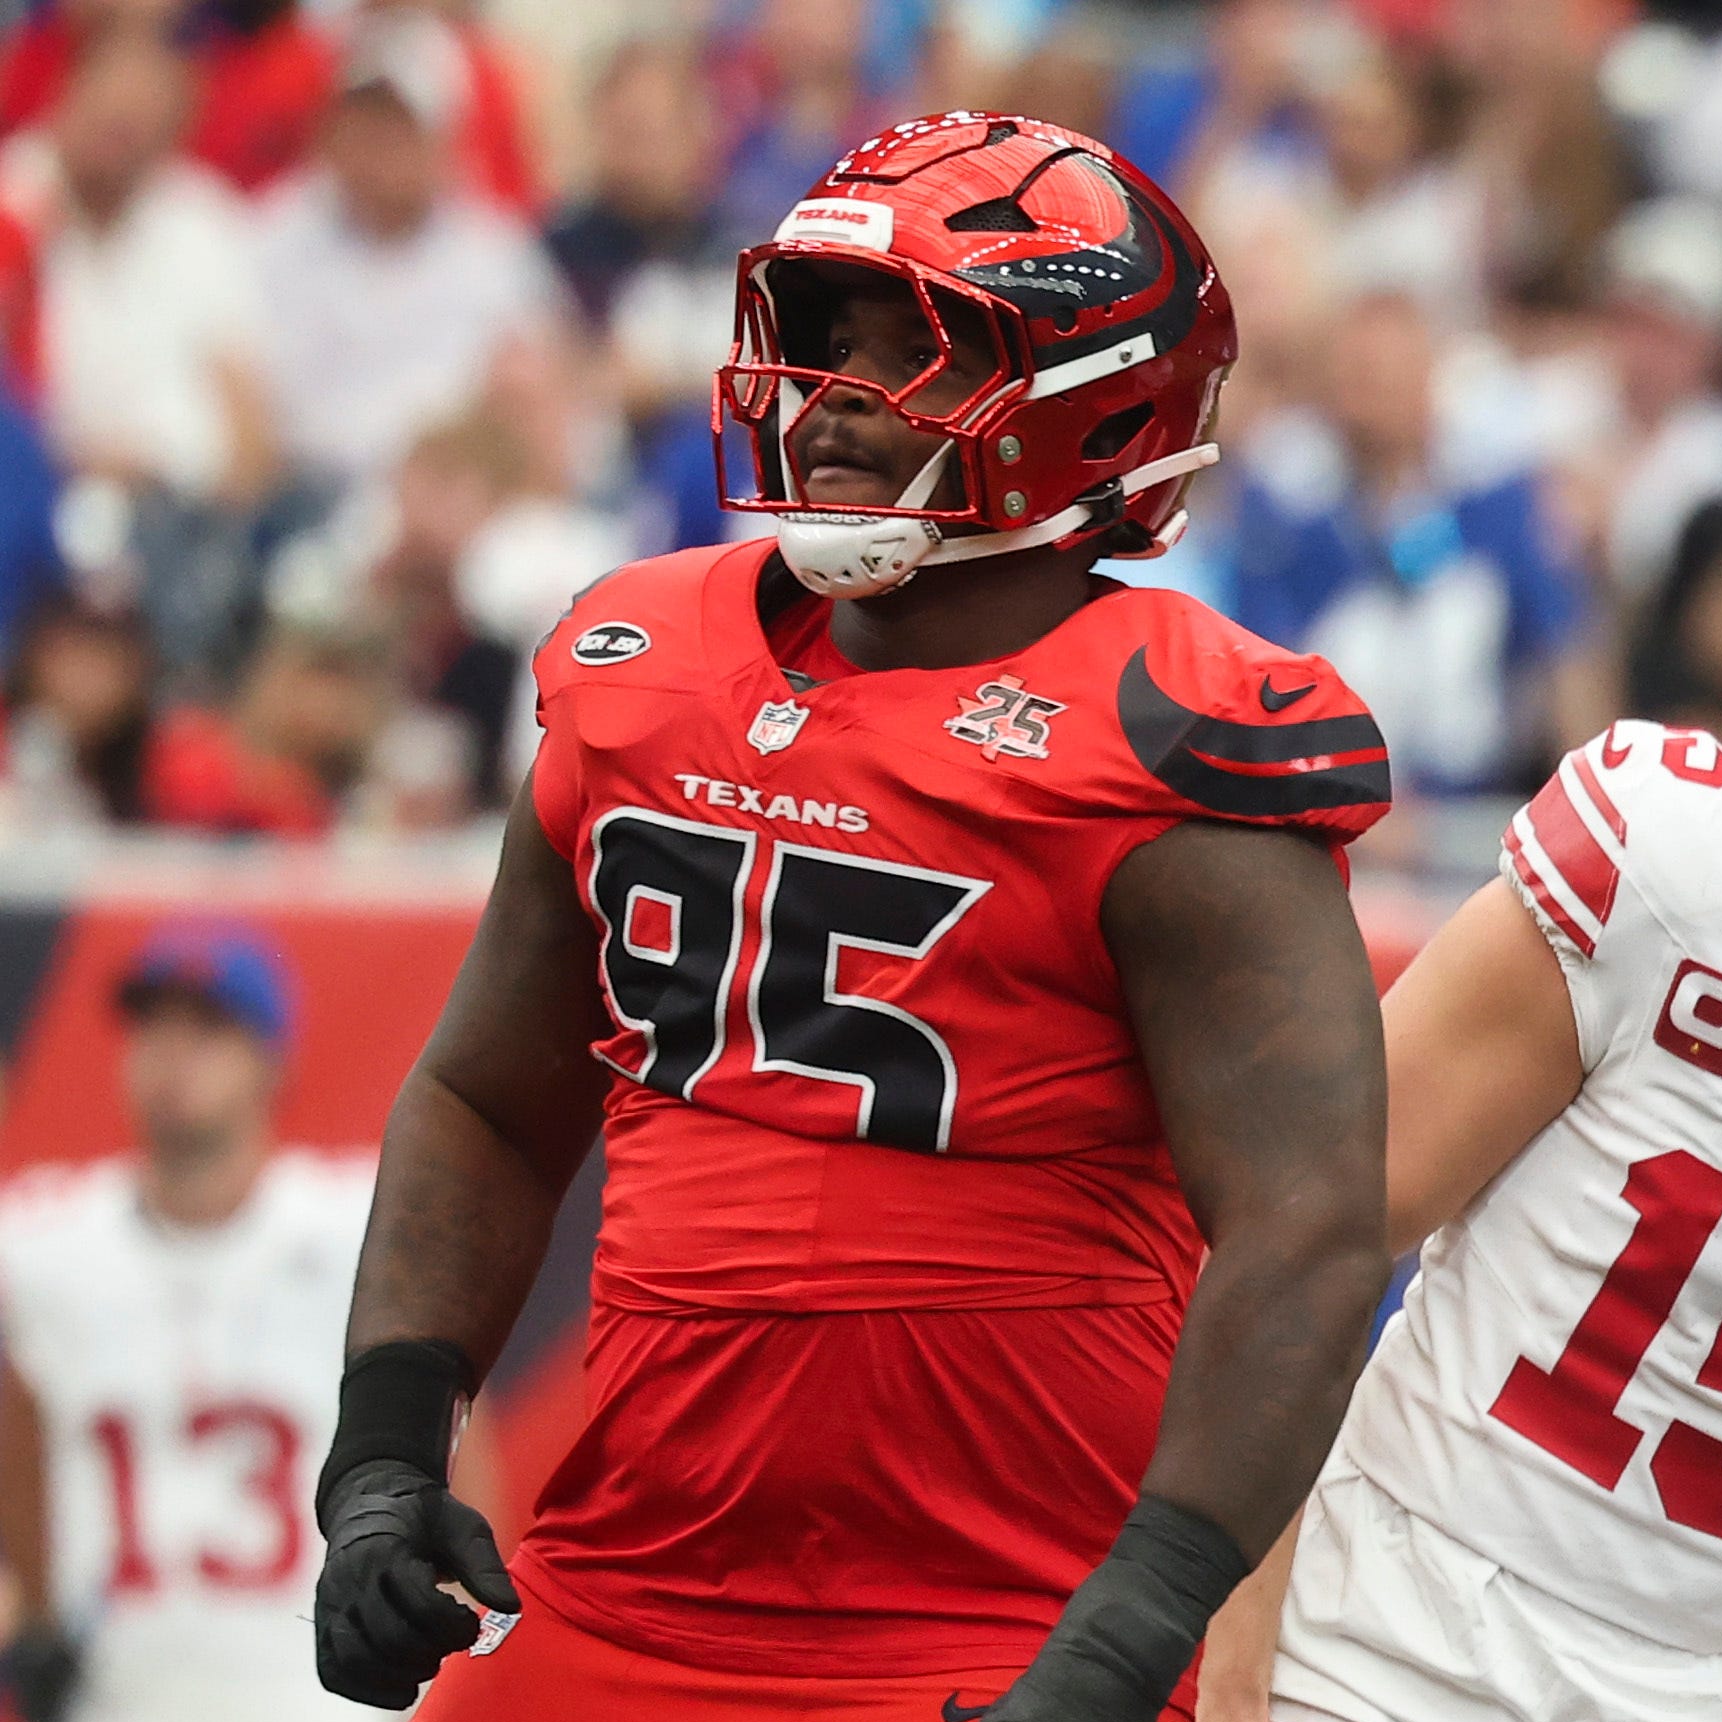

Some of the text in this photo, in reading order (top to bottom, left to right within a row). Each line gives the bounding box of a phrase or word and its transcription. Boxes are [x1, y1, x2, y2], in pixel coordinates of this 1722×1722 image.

[674, 773, 870, 834] TEXANS
[588, 805, 994, 1152] 95
[88, 1402, 306, 1592] 13
